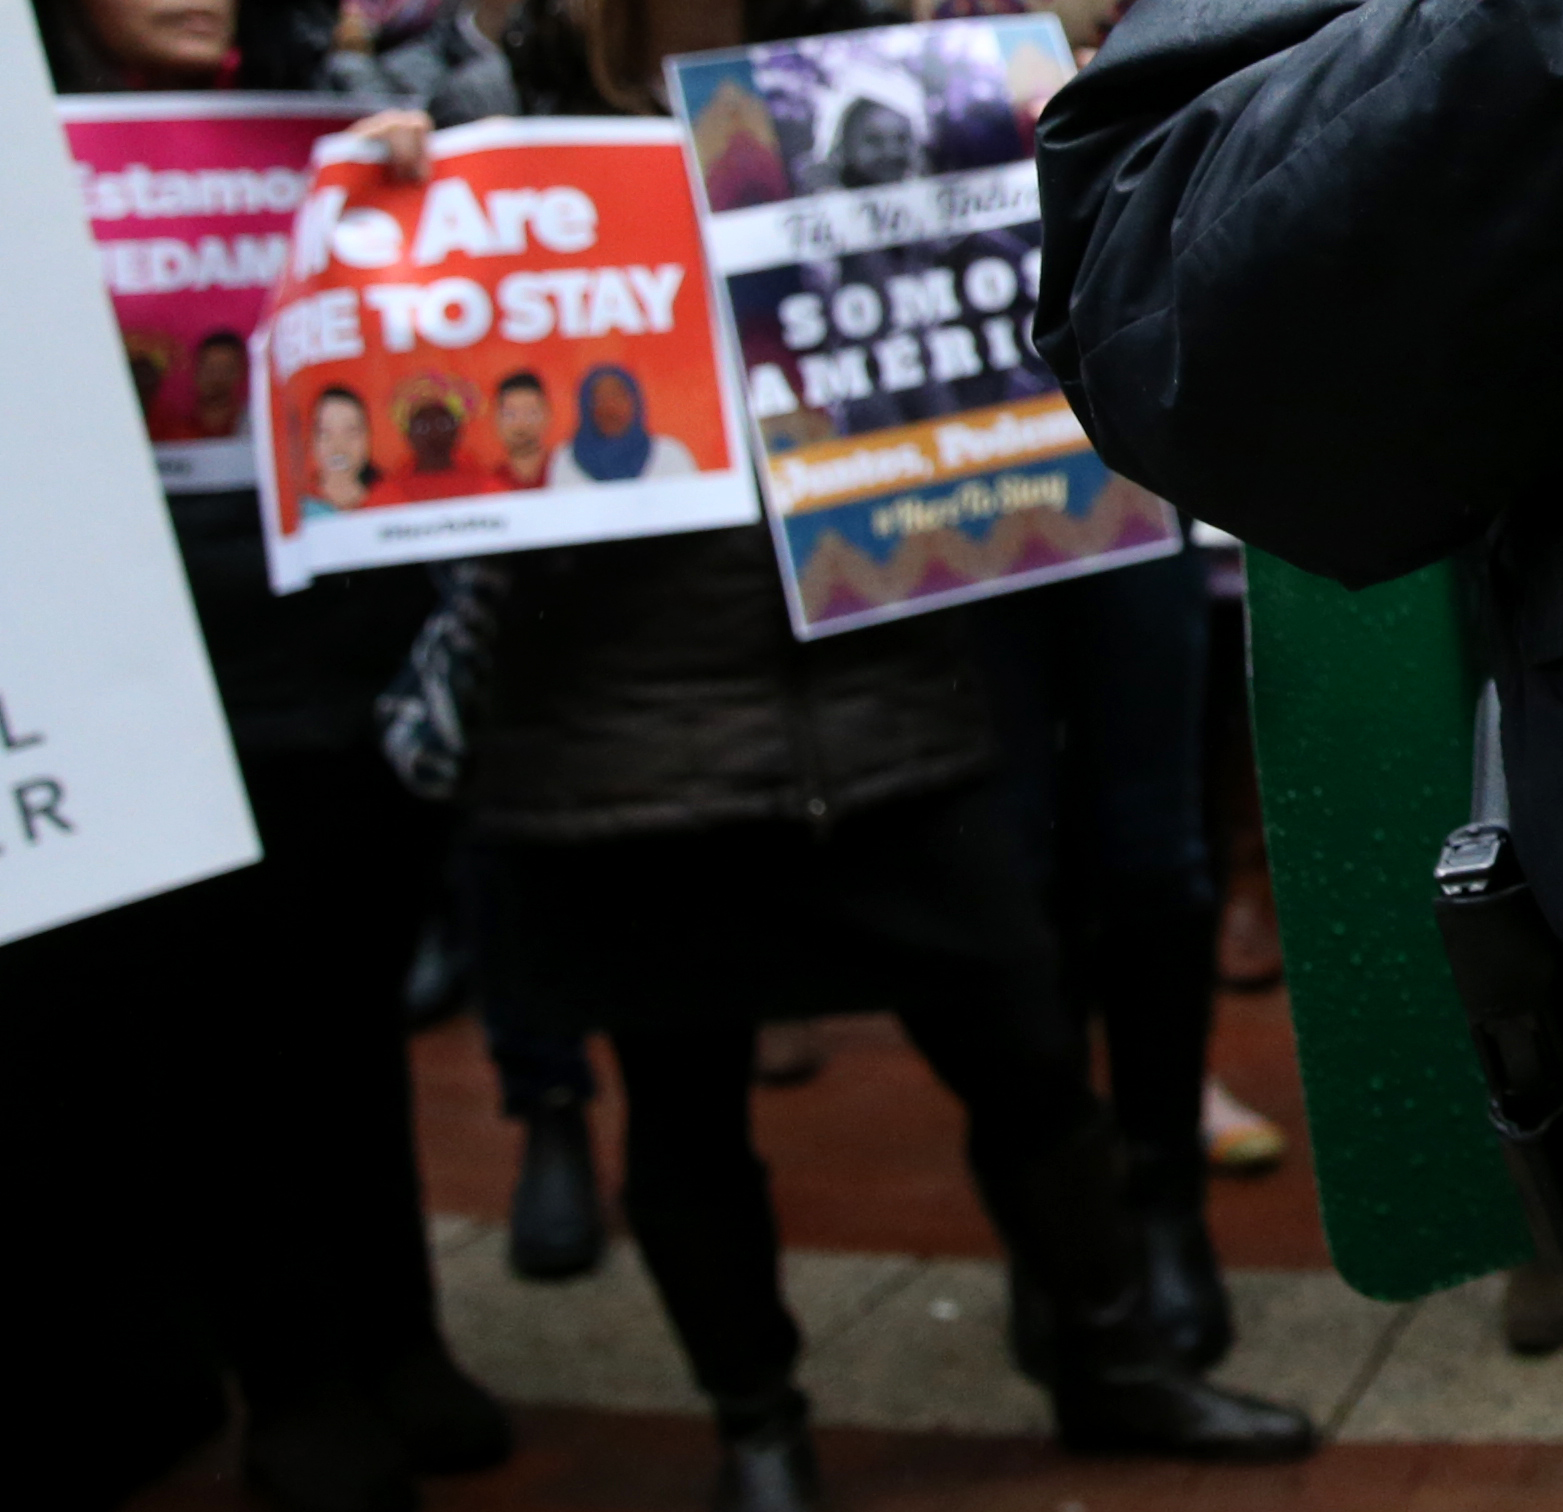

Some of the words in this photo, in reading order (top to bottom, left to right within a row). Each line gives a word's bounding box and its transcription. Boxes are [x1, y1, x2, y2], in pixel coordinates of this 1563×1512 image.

[414, 176, 600, 266] Are
[365, 275, 494, 353] TO
[500, 262, 686, 344] STAY
[747, 310, 1042, 419] AMERI
